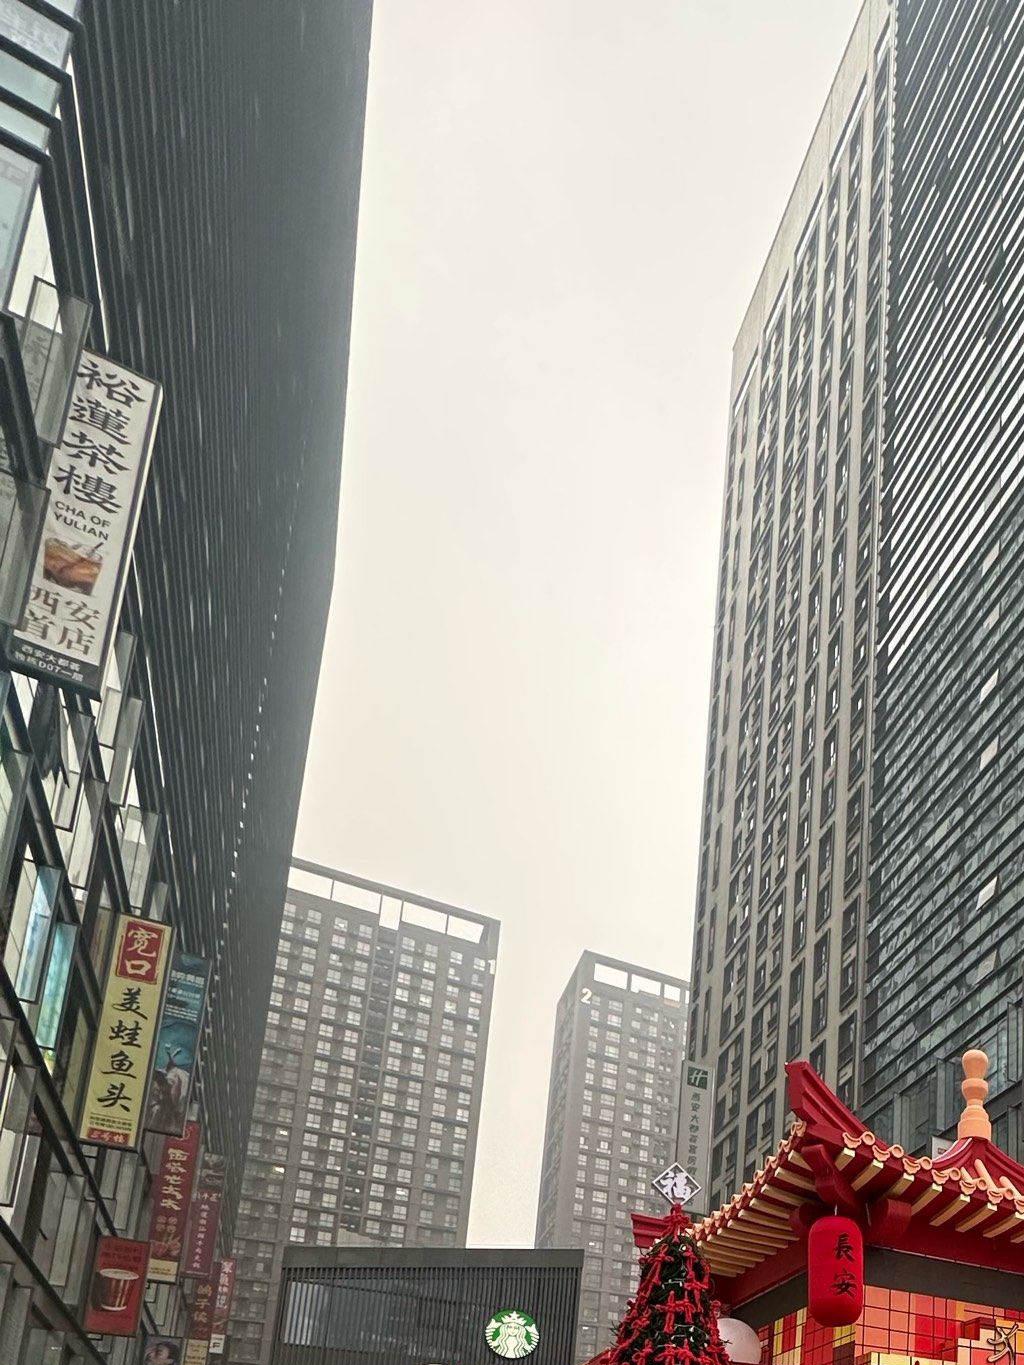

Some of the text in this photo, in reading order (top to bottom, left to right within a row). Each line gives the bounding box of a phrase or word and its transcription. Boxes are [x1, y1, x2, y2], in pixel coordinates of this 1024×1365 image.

[53, 359, 146, 513] 裕蓮茶樓
[53, 512, 109, 541] YULIAN
[54, 500, 111, 529] CHA OF
[124, 926, 158, 977] 宽口
[97, 987, 148, 1112] 美蛙鱼头
